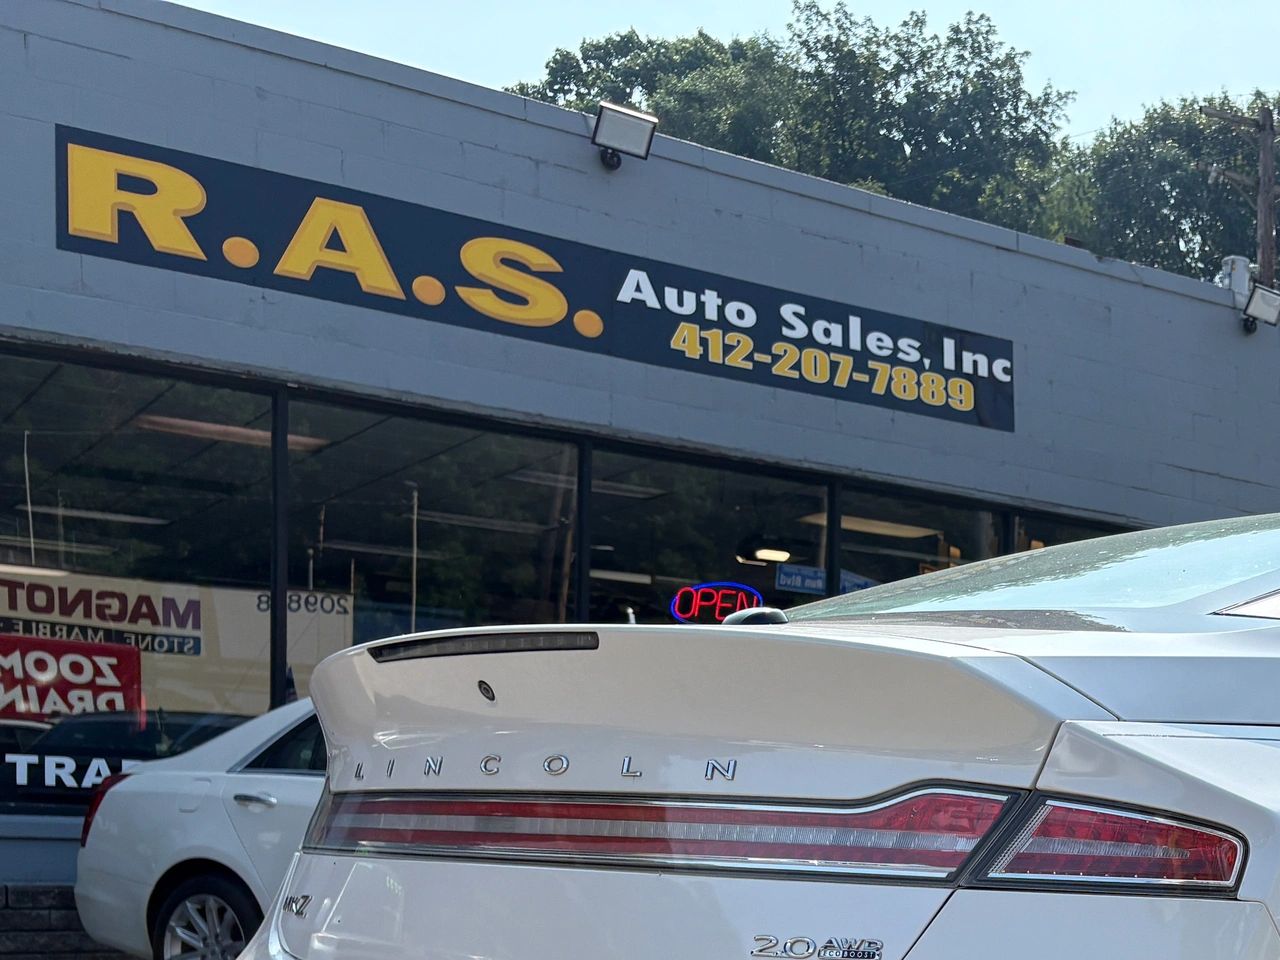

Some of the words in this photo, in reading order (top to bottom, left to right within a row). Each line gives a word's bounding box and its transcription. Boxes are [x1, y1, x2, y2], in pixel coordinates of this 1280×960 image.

[67, 142, 604, 338] R.A.S.
[616, 268, 757, 329] Auto
[779, 303, 931, 370] Sales,
[943, 338, 1012, 382] Inc
[670, 321, 975, 412] 412-207-7889
[675, 586, 758, 621] OPEN
[354, 754, 738, 781] LINCOLN
[819, 937, 884, 951] AWD
[821, 950, 878, 960] ECOBOOST
